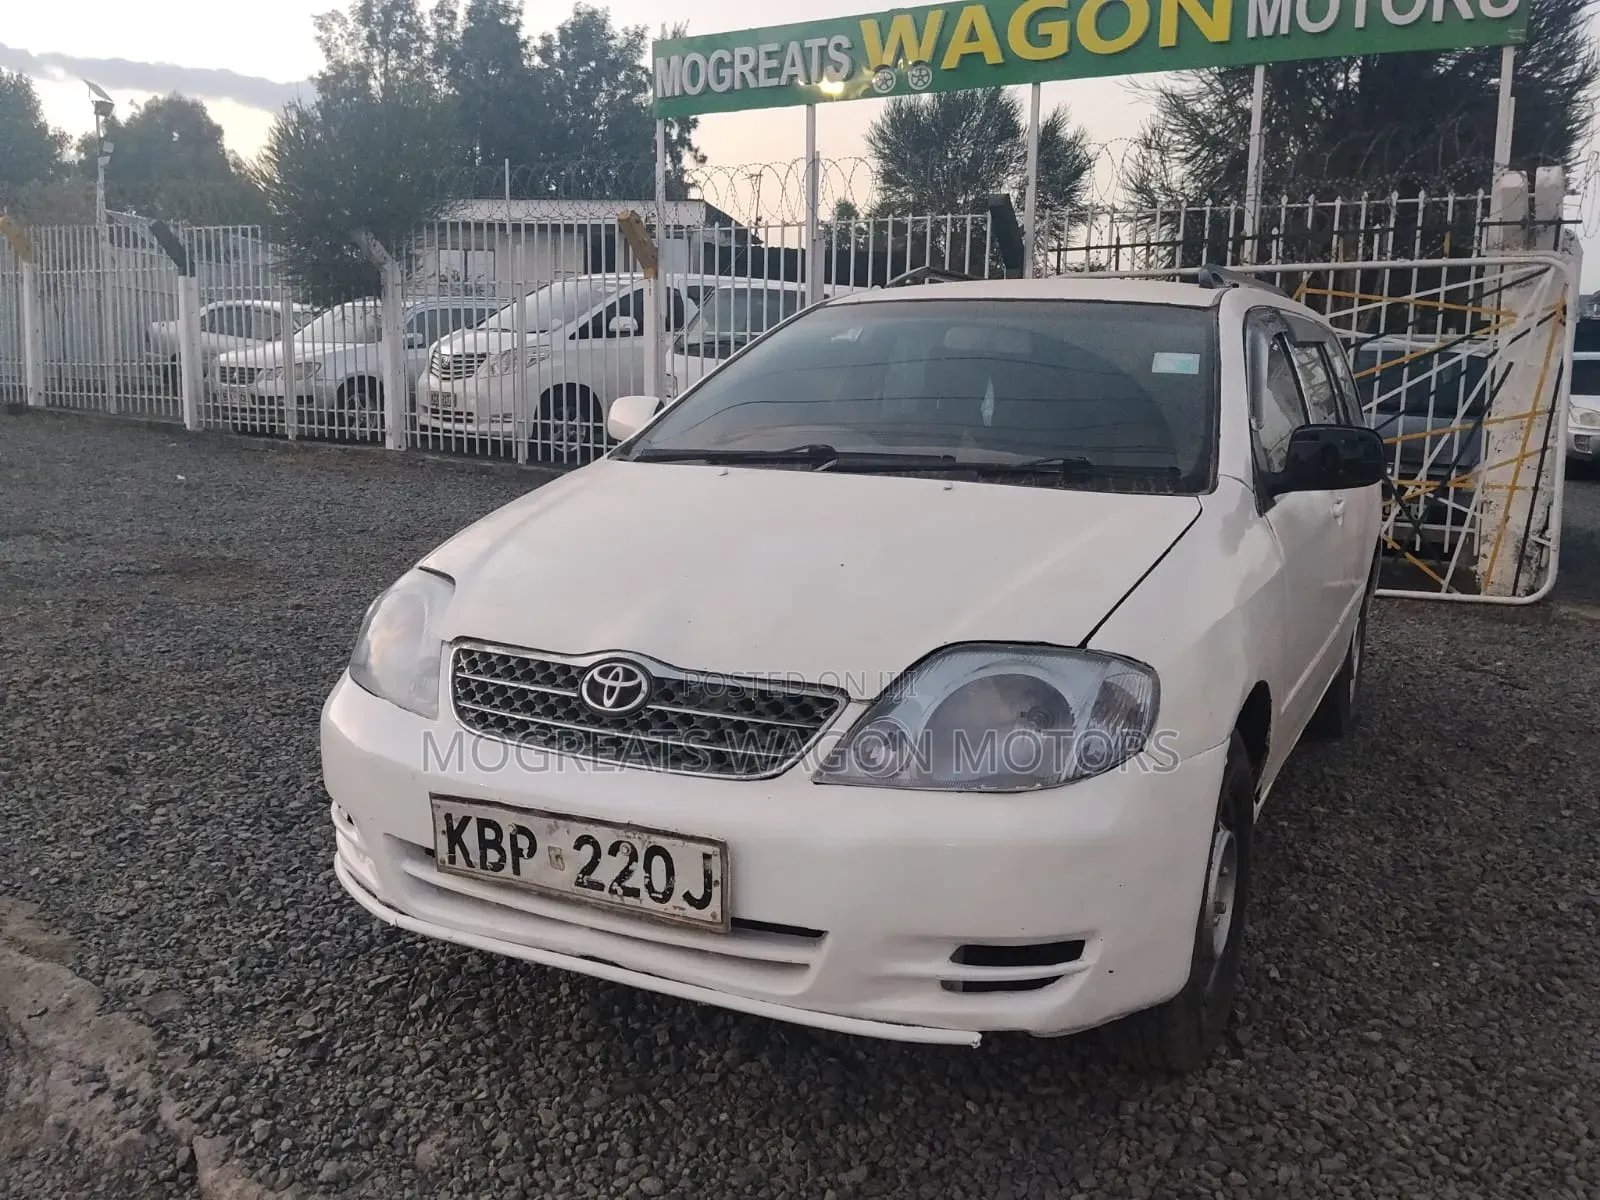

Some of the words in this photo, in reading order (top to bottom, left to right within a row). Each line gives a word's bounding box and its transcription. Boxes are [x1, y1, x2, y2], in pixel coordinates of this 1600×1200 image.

[655, 35, 851, 98] MOGREATS
[860, 0, 1231, 71] WAGON
[443, 812, 538, 877] KBP
[573, 833, 713, 911] 220J
